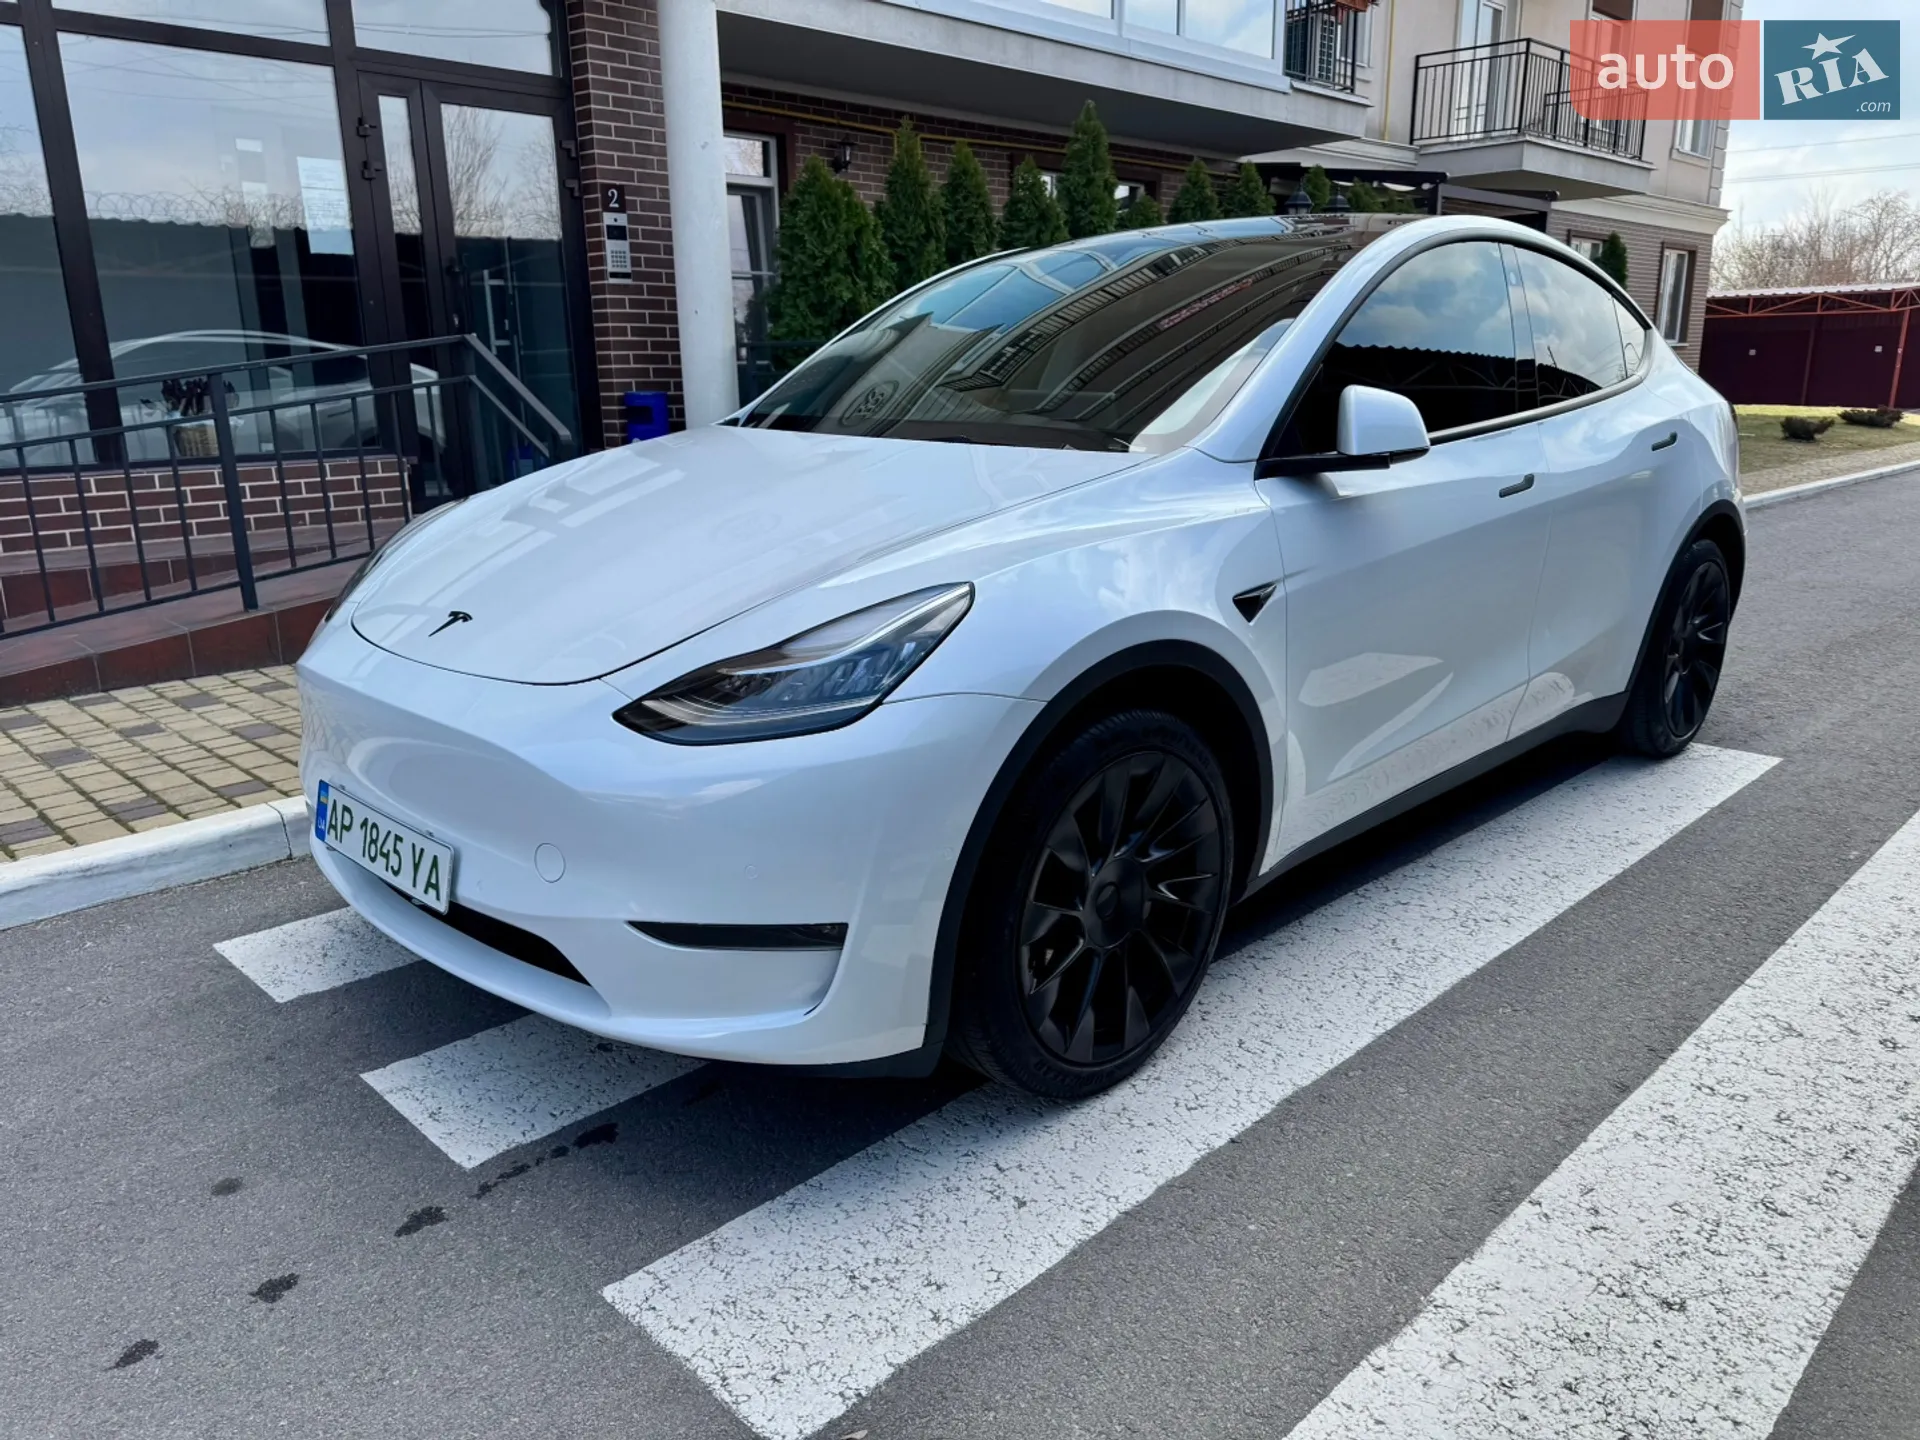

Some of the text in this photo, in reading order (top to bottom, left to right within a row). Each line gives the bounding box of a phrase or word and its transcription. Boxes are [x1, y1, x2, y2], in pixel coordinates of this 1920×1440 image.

[608, 188, 620, 208] 2
[327, 799, 441, 902] AP 1845 YA
